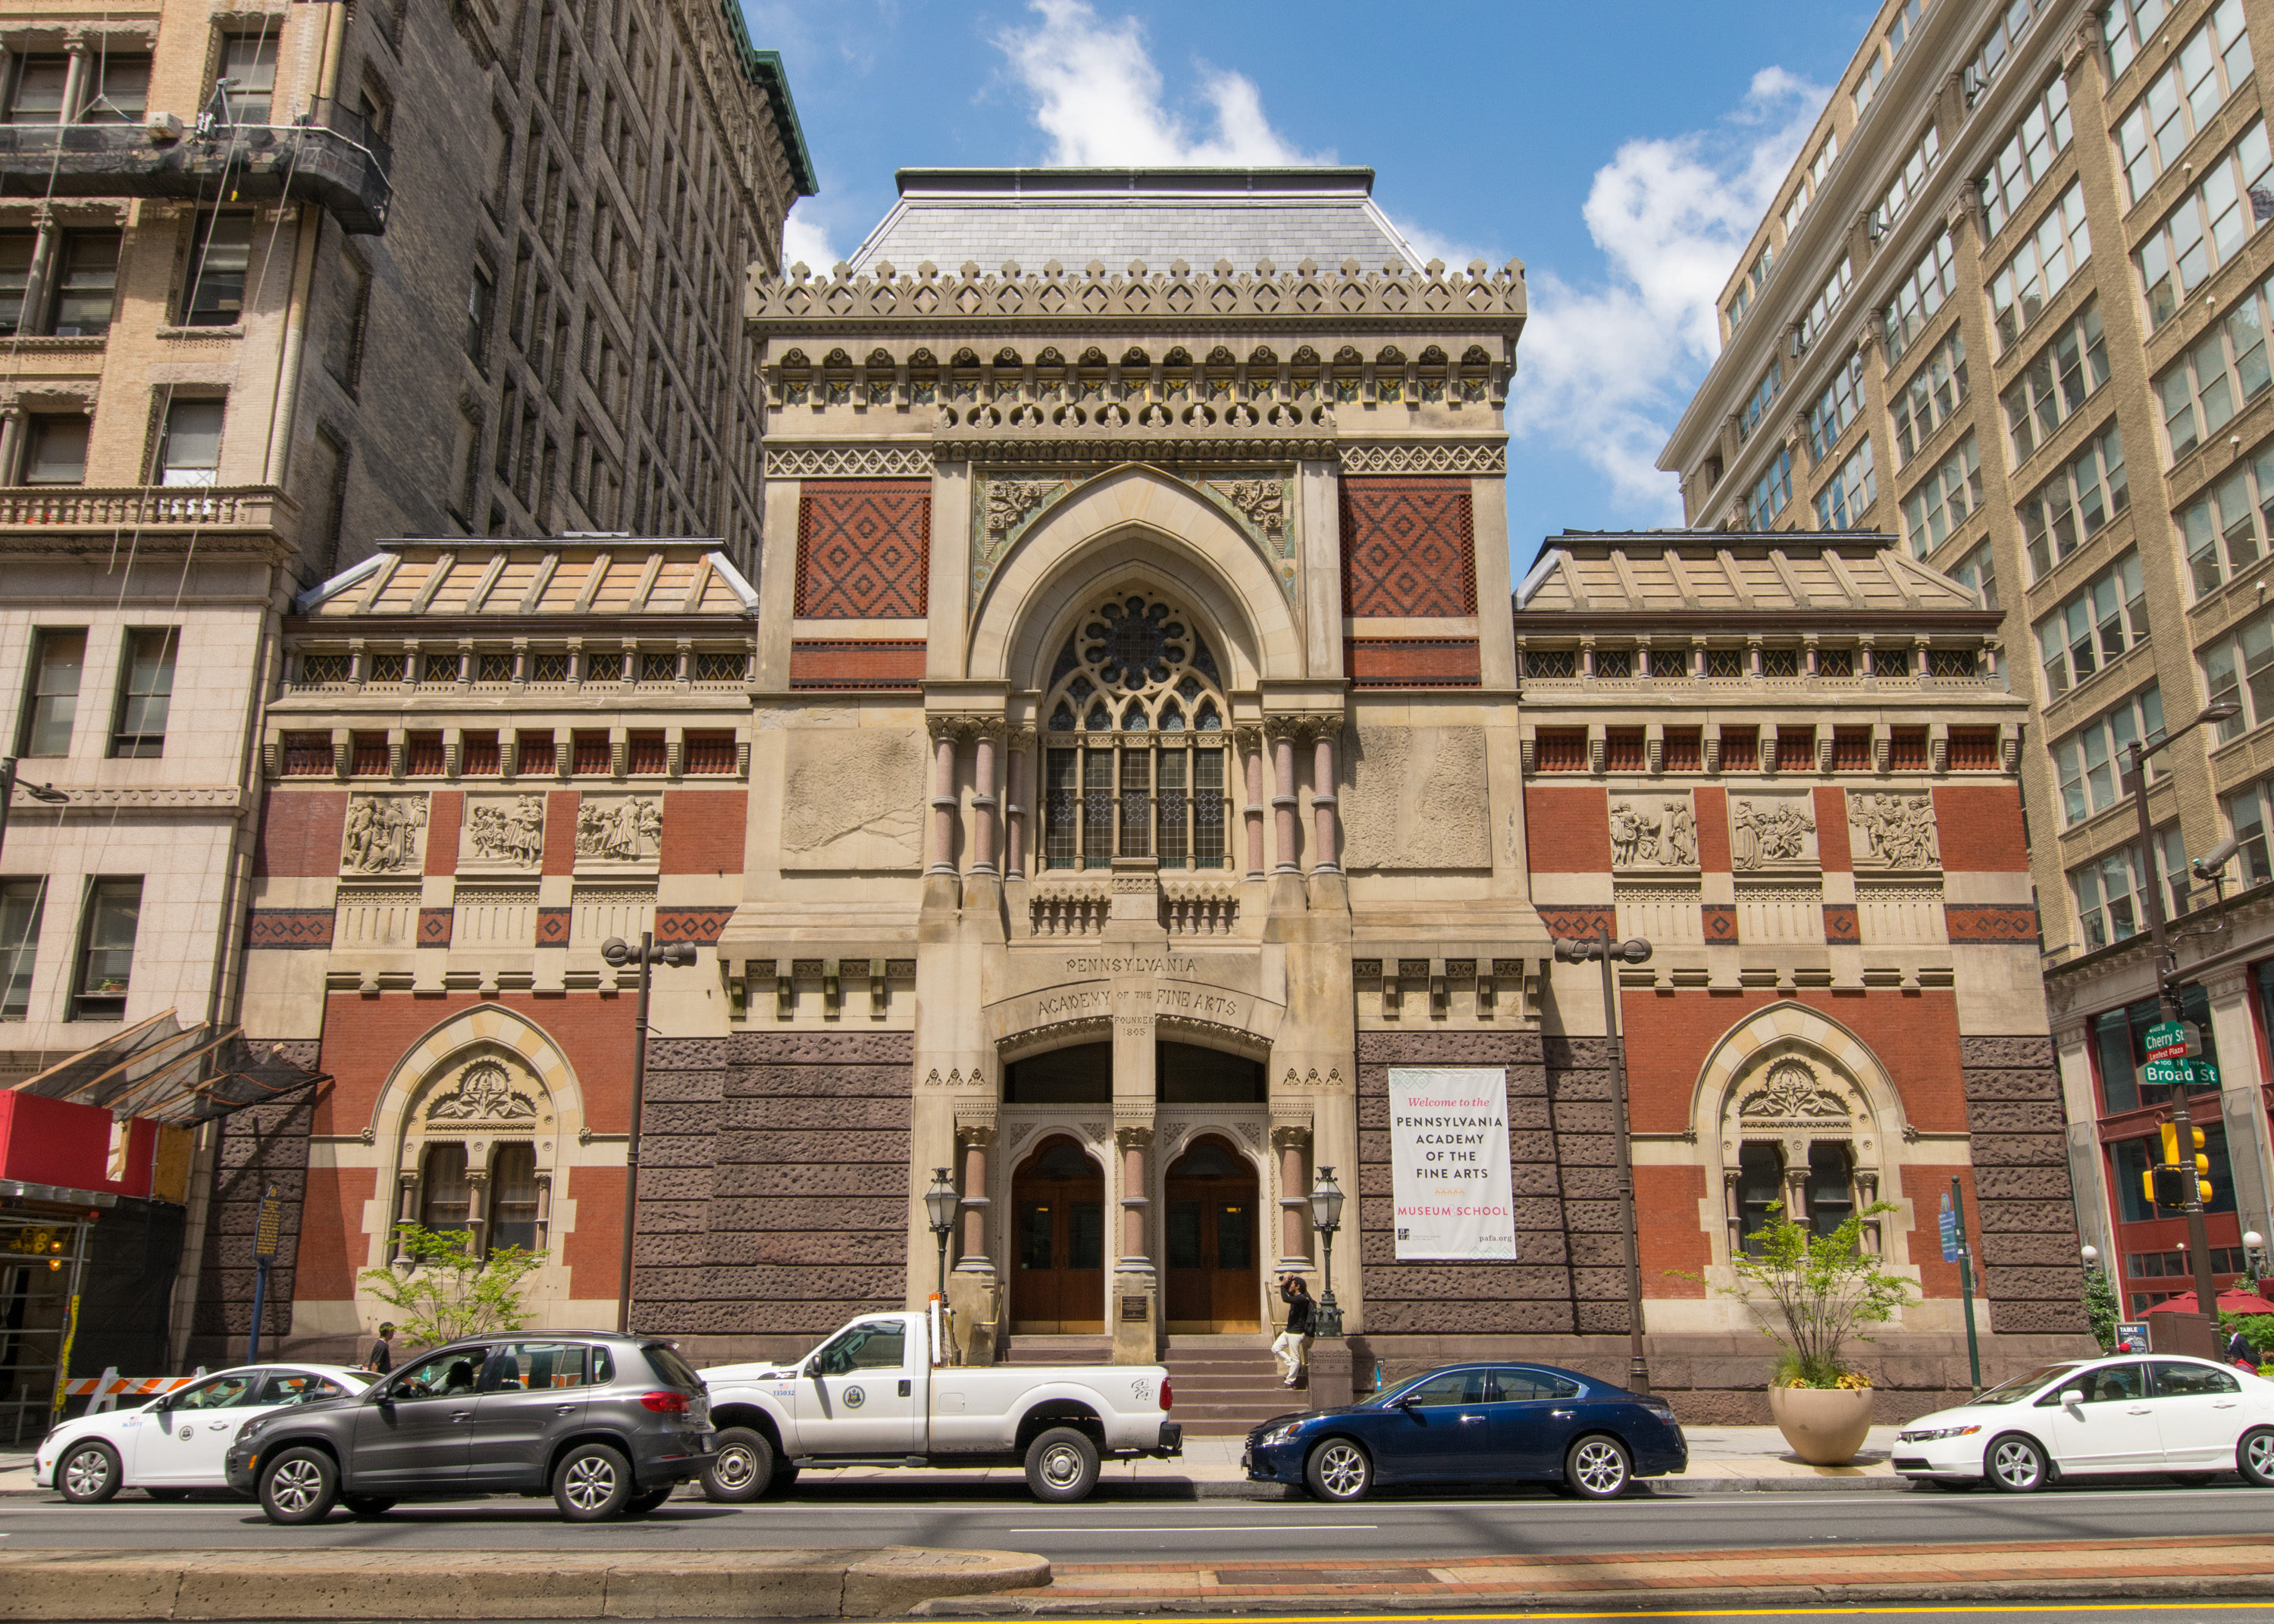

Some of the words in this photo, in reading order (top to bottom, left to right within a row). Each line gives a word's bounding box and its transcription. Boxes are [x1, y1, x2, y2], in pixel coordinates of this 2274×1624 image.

[1066, 957, 1198, 973] PENNSYLVANIA
[1038, 991, 1110, 1016] ACADEMY
[1117, 991, 1129, 1000] OF
[1135, 990, 1152, 1000] THE
[1156, 989, 1191, 1008] FINE
[1194, 993, 1237, 1017] ARTS
[1114, 1015, 1154, 1025] FOUNDED
[1123, 1027, 1146, 1037] 1805
[2146, 1033, 2173, 1050] Cherry
[2175, 1029, 2185, 1042] St
[2149, 1050, 2169, 1061] Lenfest
[2169, 1047, 2184, 1056] Plaza
[2147, 1067, 2194, 1081] Broad
[2200, 1069, 2216, 1081] St
[1408, 1097, 1458, 1107] Welcome
[1459, 1098, 1470, 1107] to
[1472, 1097, 1489, 1107] the
[1396, 1117, 1503, 1128] PENNSYLVANIA
[1415, 1134, 1484, 1144] ACADEMY
[1426, 1152, 1444, 1161] OF
[1449, 1151, 1477, 1161] THE
[1416, 1169, 1449, 1178] FINE
[1453, 1169, 1489, 1178] ARTS
[1397, 1206, 1452, 1216] MUSEUM
[1456, 1206, 1508, 1216] SCHOOL
[1479, 1234, 1513, 1243] pafa.org
